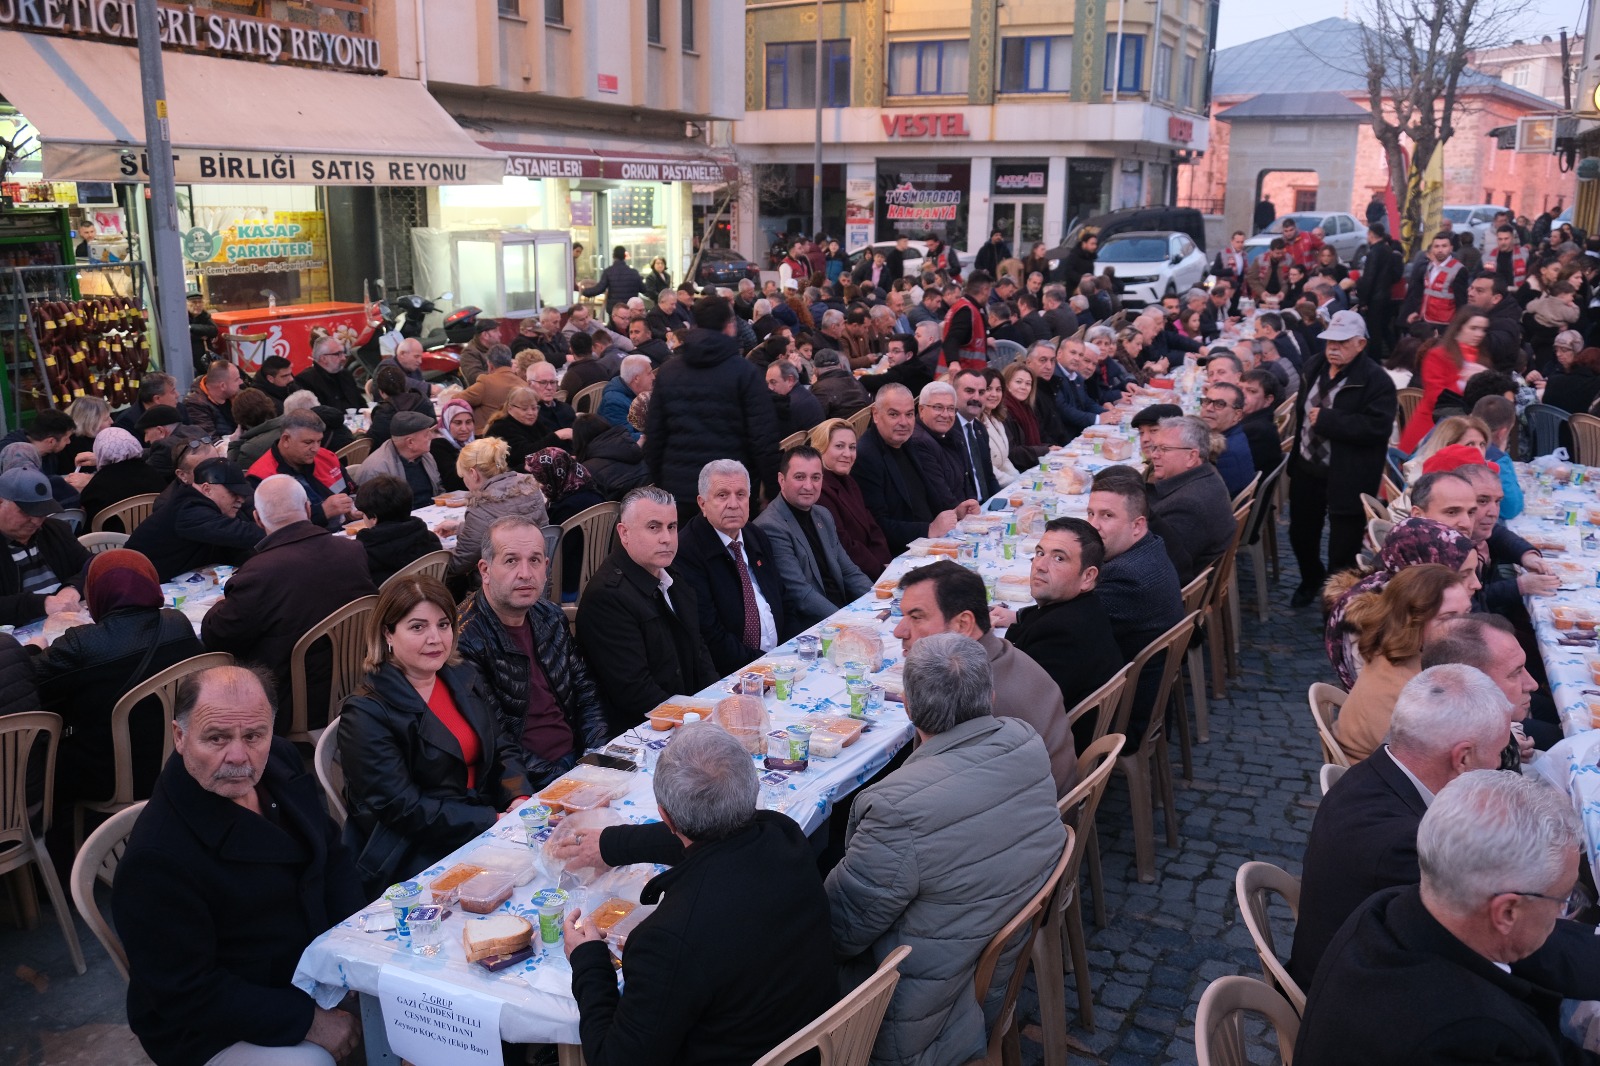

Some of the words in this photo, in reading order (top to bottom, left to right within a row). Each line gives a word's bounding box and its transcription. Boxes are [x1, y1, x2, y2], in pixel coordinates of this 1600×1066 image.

[208, 16, 282, 61] SATIŞ
[290, 28, 381, 69] REYONU
[881, 113, 970, 137] VESTEL
[312, 159, 375, 183] SATIŞ
[389, 161, 467, 181] REYONU
[621, 163, 659, 179] ORKUN
[887, 205, 956, 219] KAMPANYA
[237, 224, 301, 239] KASAP
[396, 995, 417, 1009] GAZİ
[418, 1002, 454, 1020] CADDESİ
[456, 1013, 481, 1028] TELLİ
[430, 994, 453, 1009] GRUP
[393, 1018, 418, 1034] Zeynep
[448, 1038, 469, 1051] (Ekip
[404, 1009, 432, 1026] ÇEŞME
[433, 1019, 473, 1037] MEYDANI
